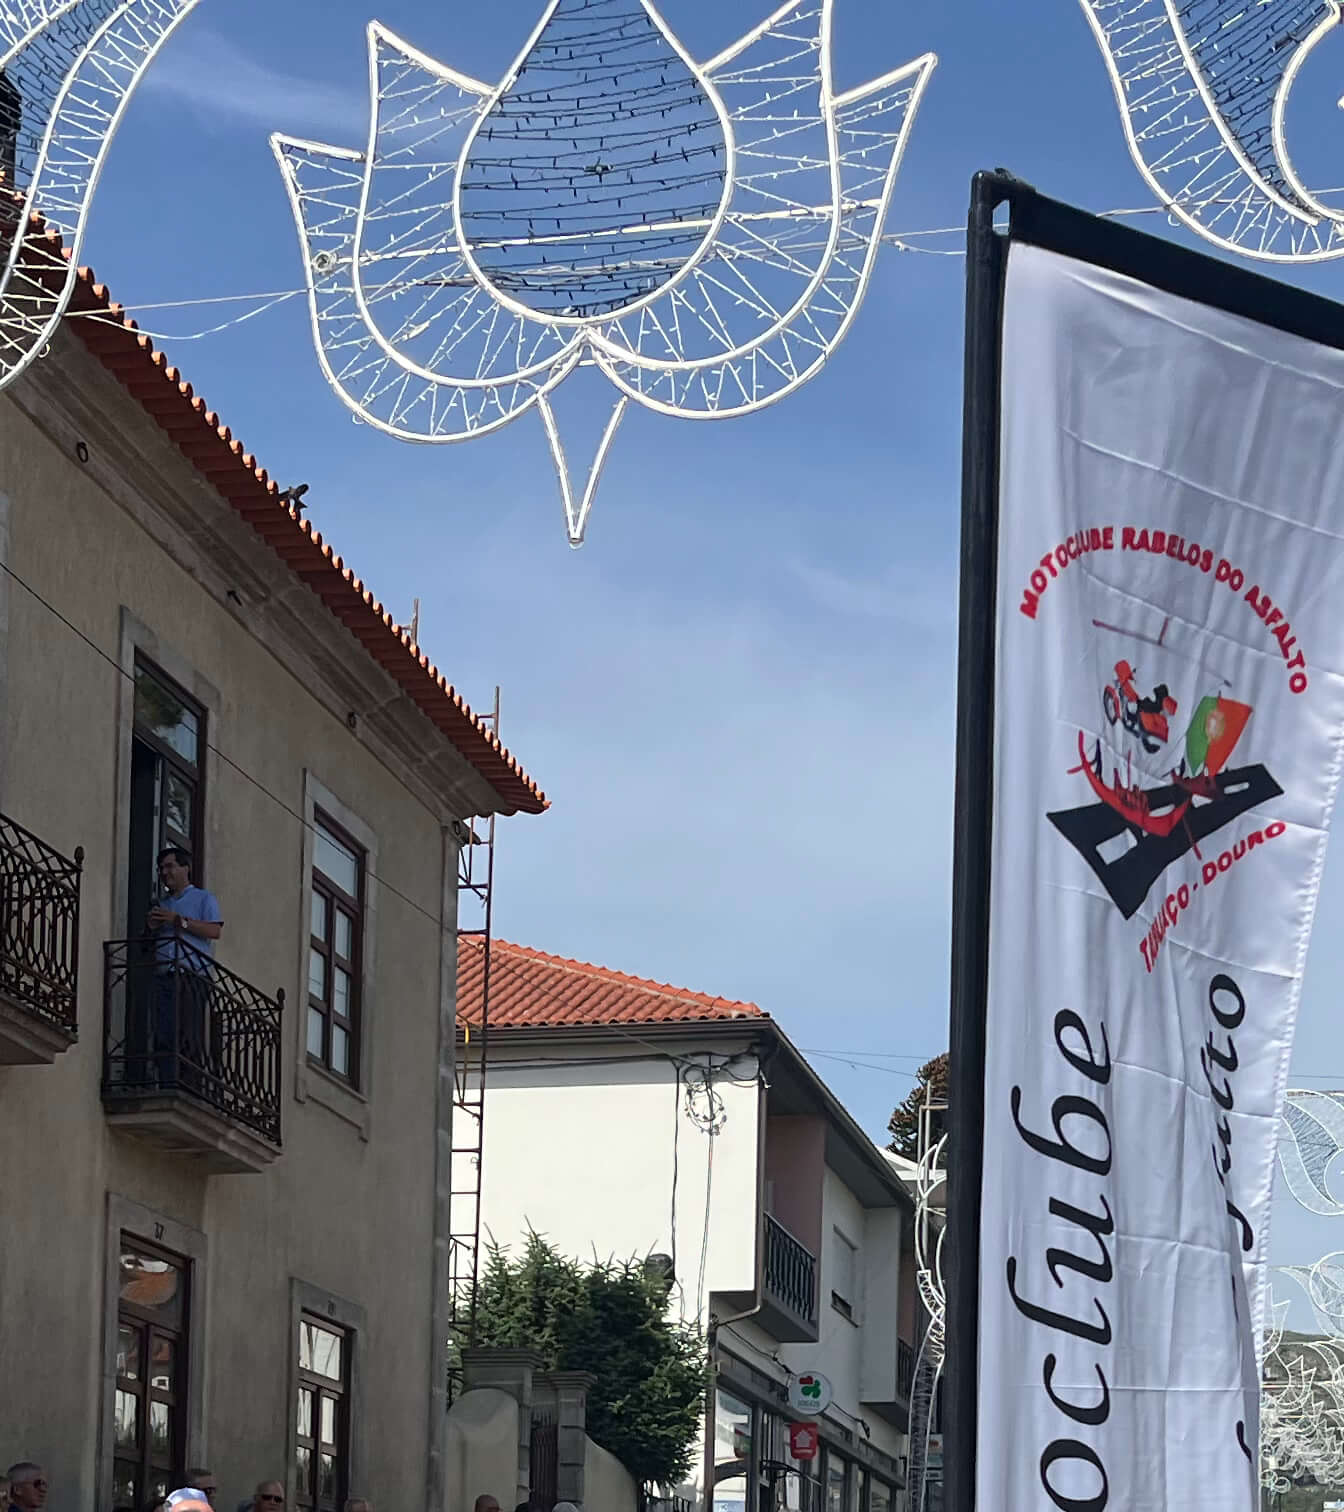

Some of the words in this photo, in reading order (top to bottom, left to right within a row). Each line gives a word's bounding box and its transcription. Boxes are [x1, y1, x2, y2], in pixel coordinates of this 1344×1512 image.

[1020, 526, 1113, 619] MOTOCLUBE
[1122, 527, 1213, 573] RABELOS
[1215, 559, 1244, 591] DO
[1244, 585, 1307, 694] ASFALTO
[1202, 821, 1286, 885] DOURO
